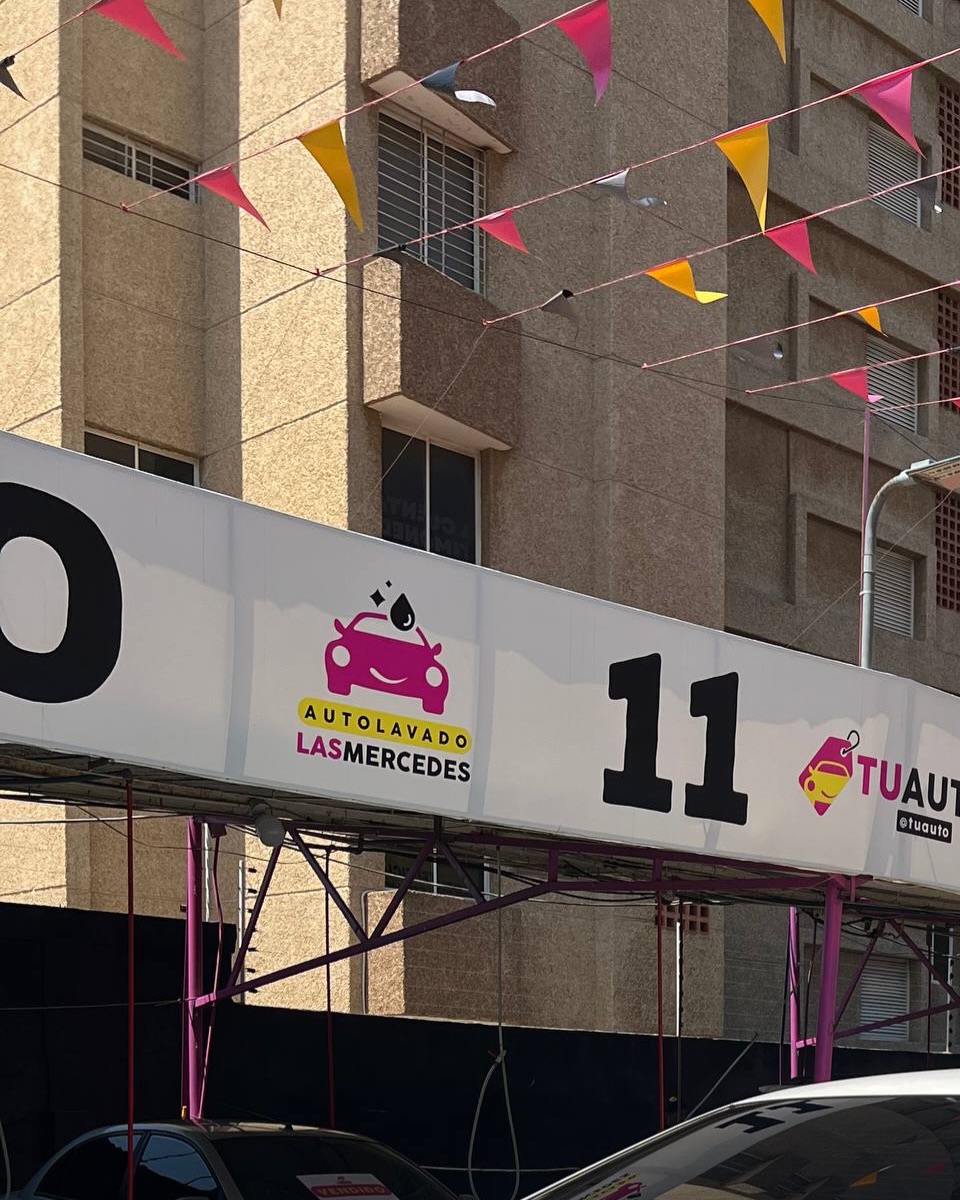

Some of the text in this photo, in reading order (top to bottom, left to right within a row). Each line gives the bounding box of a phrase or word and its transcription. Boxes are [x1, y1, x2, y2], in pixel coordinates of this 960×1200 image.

[303, 704, 468, 750] AUTOLAVADO
[602, 652, 749, 826] 11
[296, 730, 472, 784] LASMERCEDES
[898, 816, 950, 839] @tuauto
